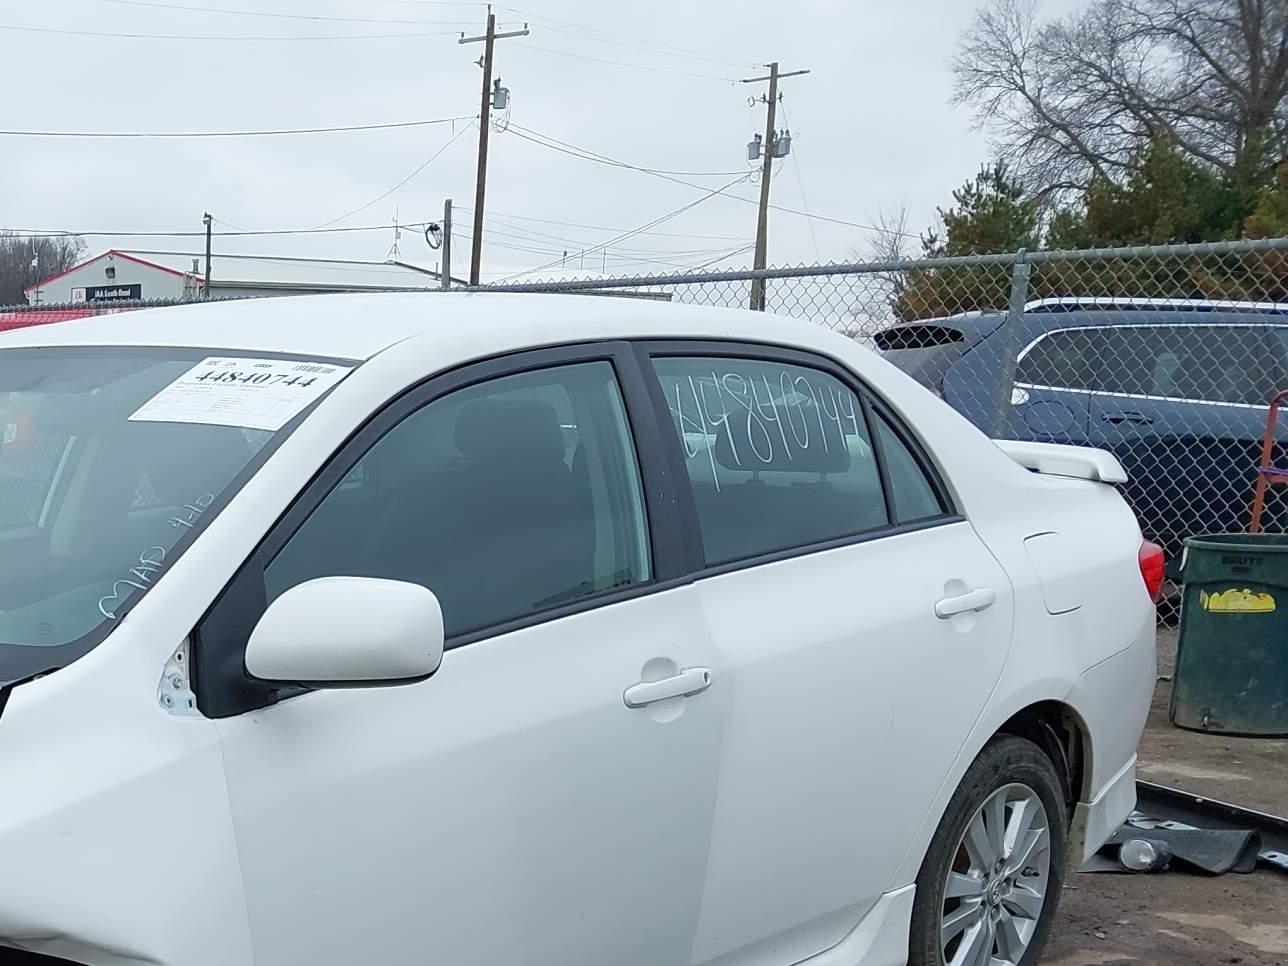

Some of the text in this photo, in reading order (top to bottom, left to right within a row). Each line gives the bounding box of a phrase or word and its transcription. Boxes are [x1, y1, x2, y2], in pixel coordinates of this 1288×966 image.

[195, 371, 319, 388] 44840744
[670, 371, 865, 490] 44840744
[1222, 555, 1264, 566] BRUTE
